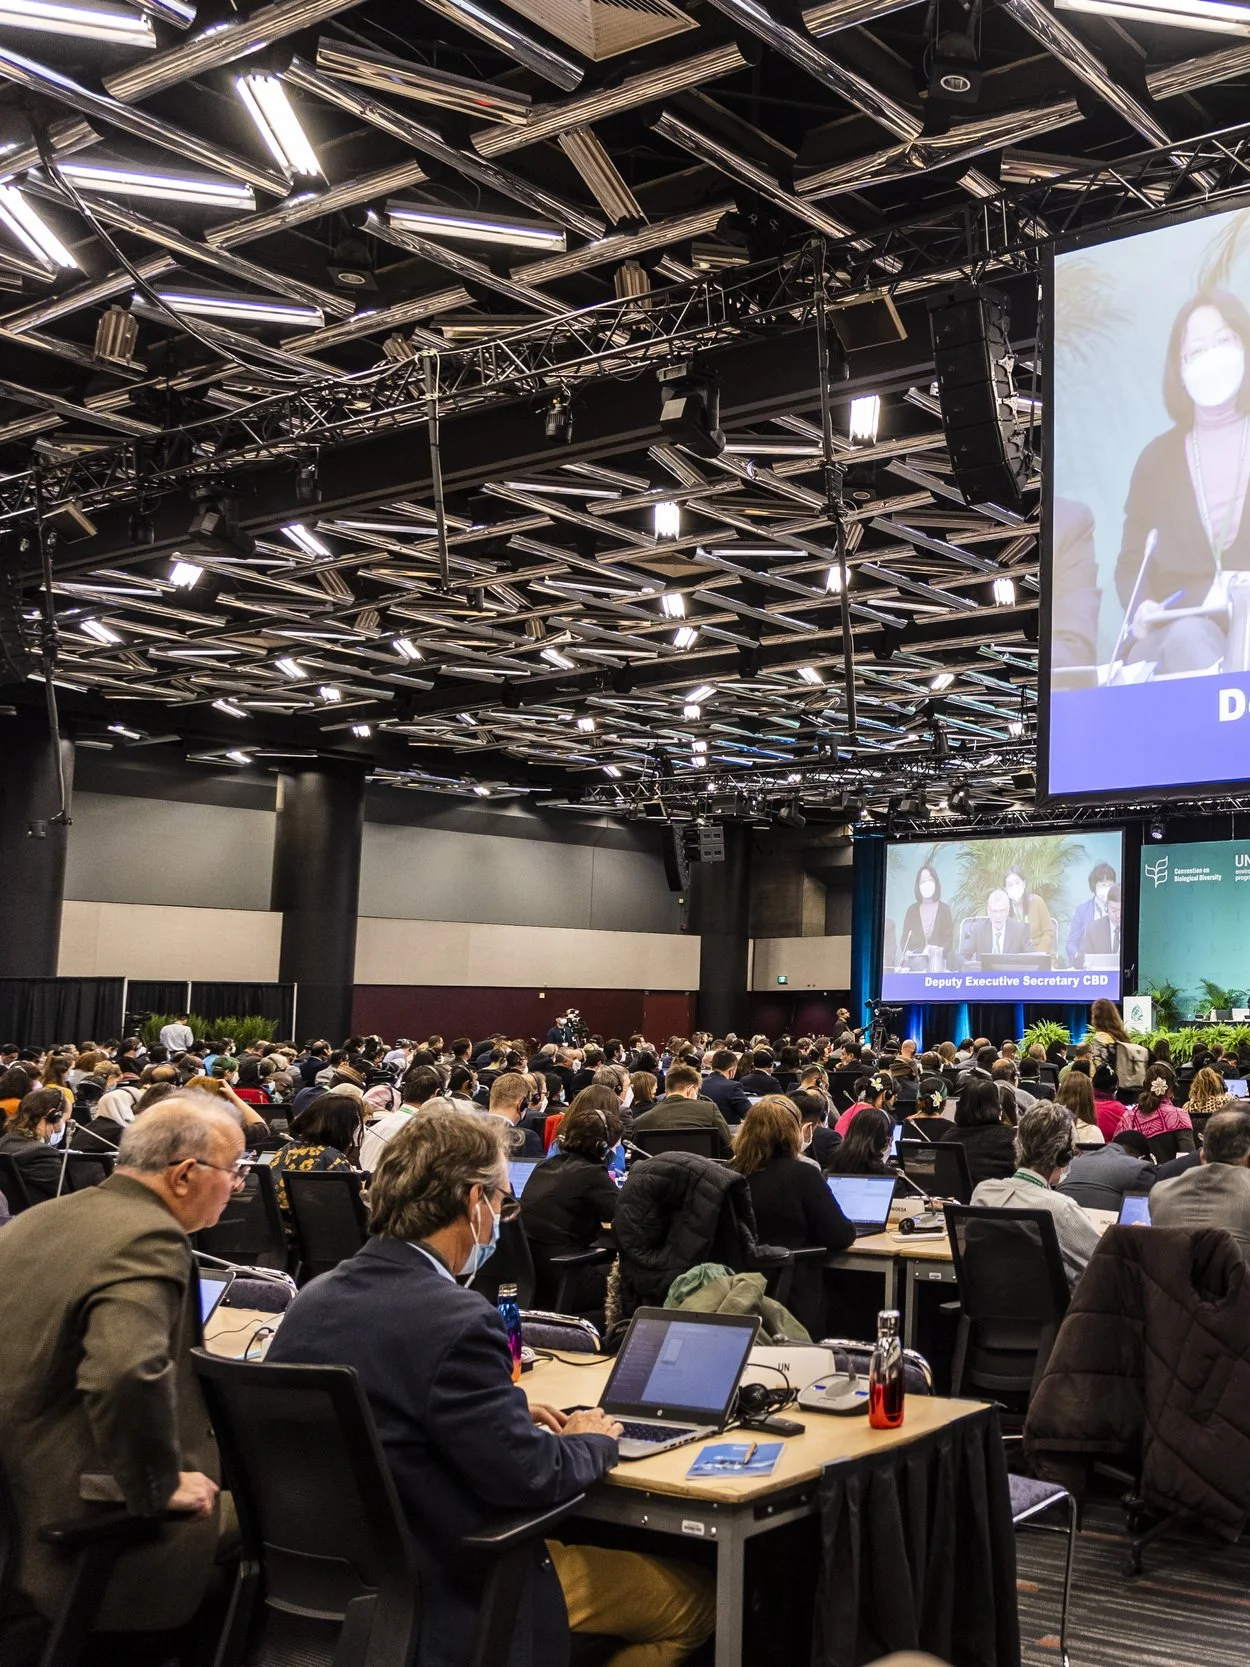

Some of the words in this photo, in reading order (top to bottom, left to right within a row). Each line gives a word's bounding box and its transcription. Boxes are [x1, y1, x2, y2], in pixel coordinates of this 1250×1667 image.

[1174, 875, 1199, 883] Biological
[1199, 874, 1222, 882] Diversity
[925, 976, 962, 989] Deputy
[966, 975, 1019, 987] Executive
[1023, 975, 1080, 988] Secretary
[1083, 974, 1109, 986] CBD
[778, 1362, 790, 1372] UN
